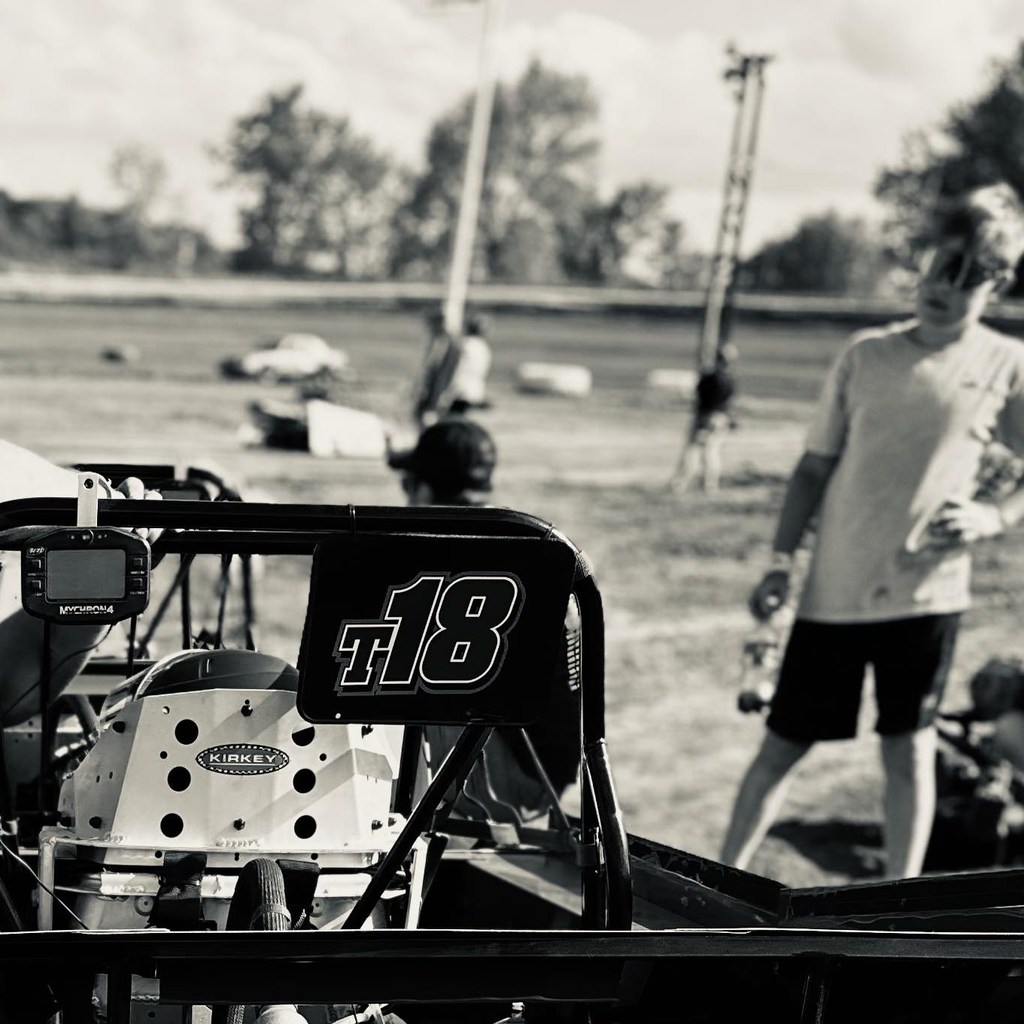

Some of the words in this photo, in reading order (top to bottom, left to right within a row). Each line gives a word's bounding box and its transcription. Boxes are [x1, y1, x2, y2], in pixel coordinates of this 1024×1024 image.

[59, 605, 114, 615] MYCHRON4
[334, 572, 524, 693] T18
[209, 753, 276, 763] KIRKEY
